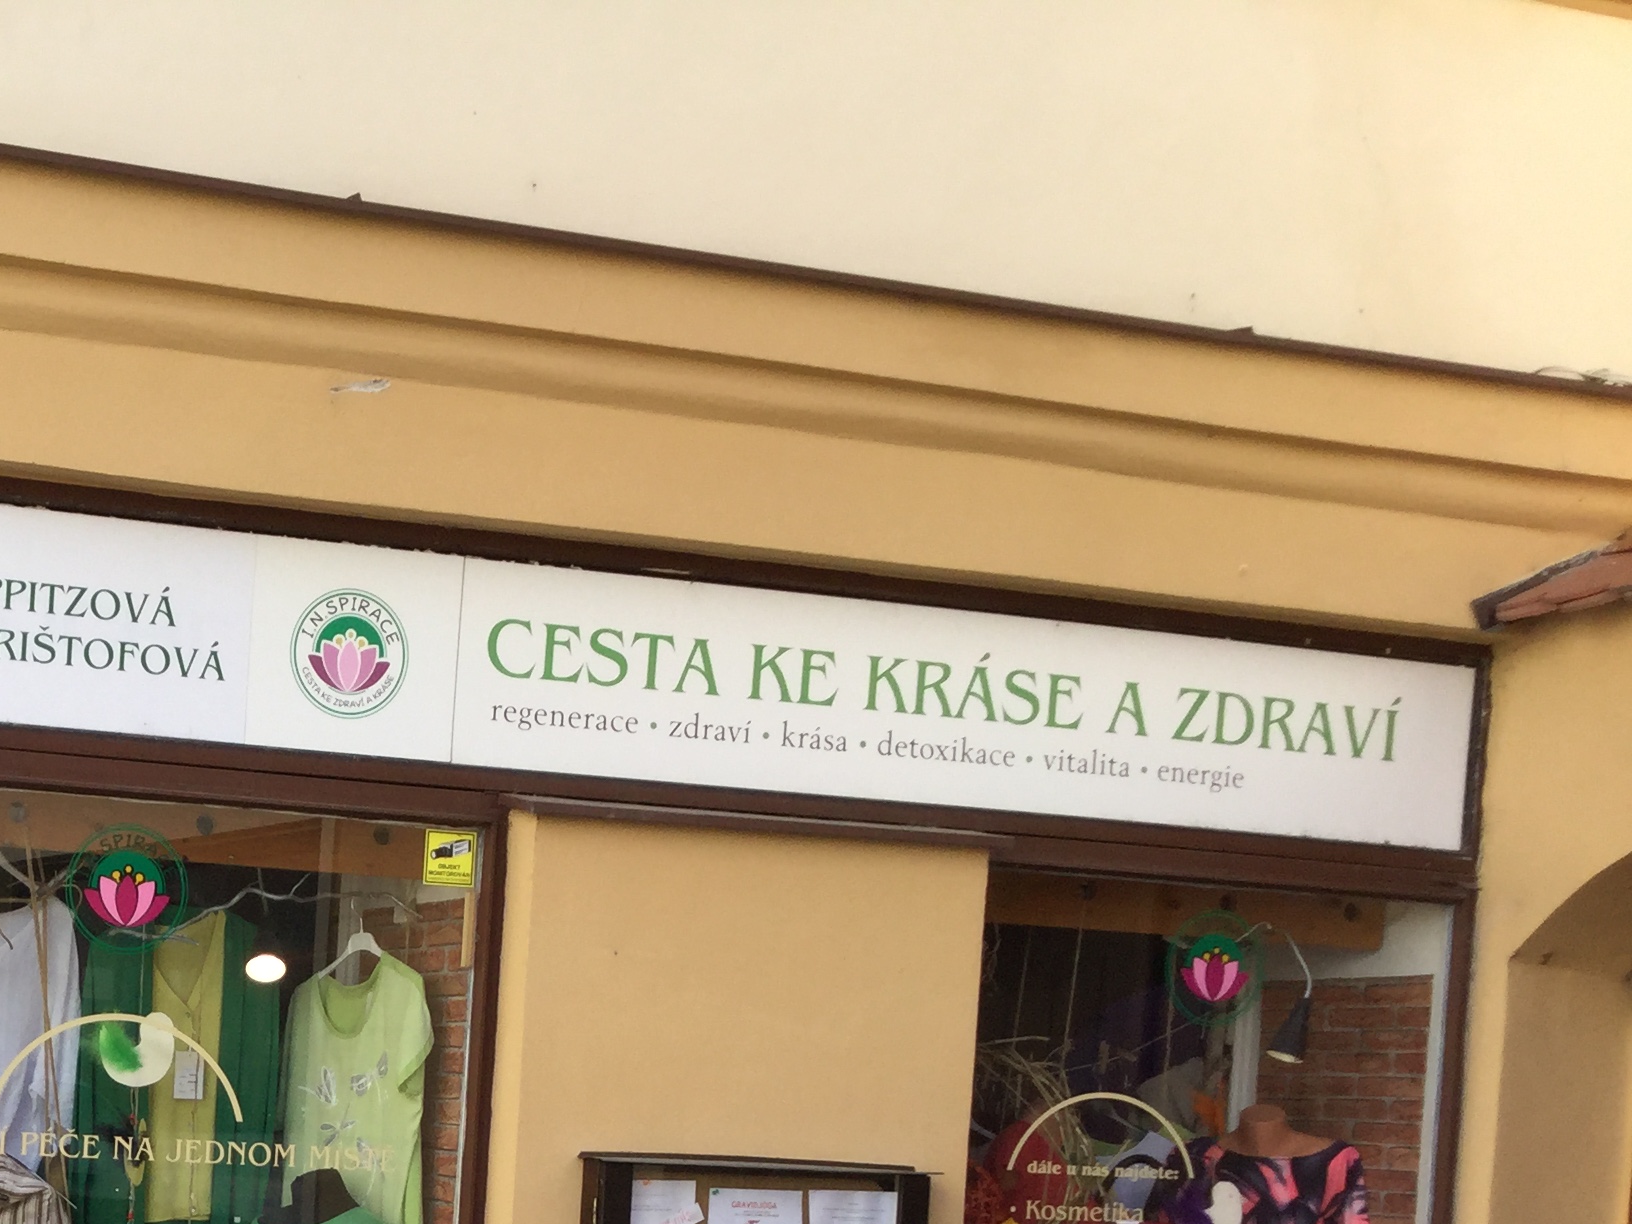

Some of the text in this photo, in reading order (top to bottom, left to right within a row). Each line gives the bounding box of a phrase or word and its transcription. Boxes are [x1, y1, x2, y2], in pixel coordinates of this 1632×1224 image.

[302, 666, 395, 708] CESTA KE ZDRAVÍ A KRÁSE
[487, 617, 1404, 763] CESTA KE KRÁSE A ZDRAVÍ
[490, 701, 1245, 794] regenerace zdraví krása detoxikace vitalita energie
[20, 1126, 101, 1160] PÉČE
[112, 1135, 155, 1162] NA
[165, 1137, 296, 1169] JEDNOM
[309, 1140, 396, 1173] MÍSTĚ
[1027, 1160, 1180, 1182] dále u nás najdete:
[1025, 1200, 1145, 1223] Kosmetika
